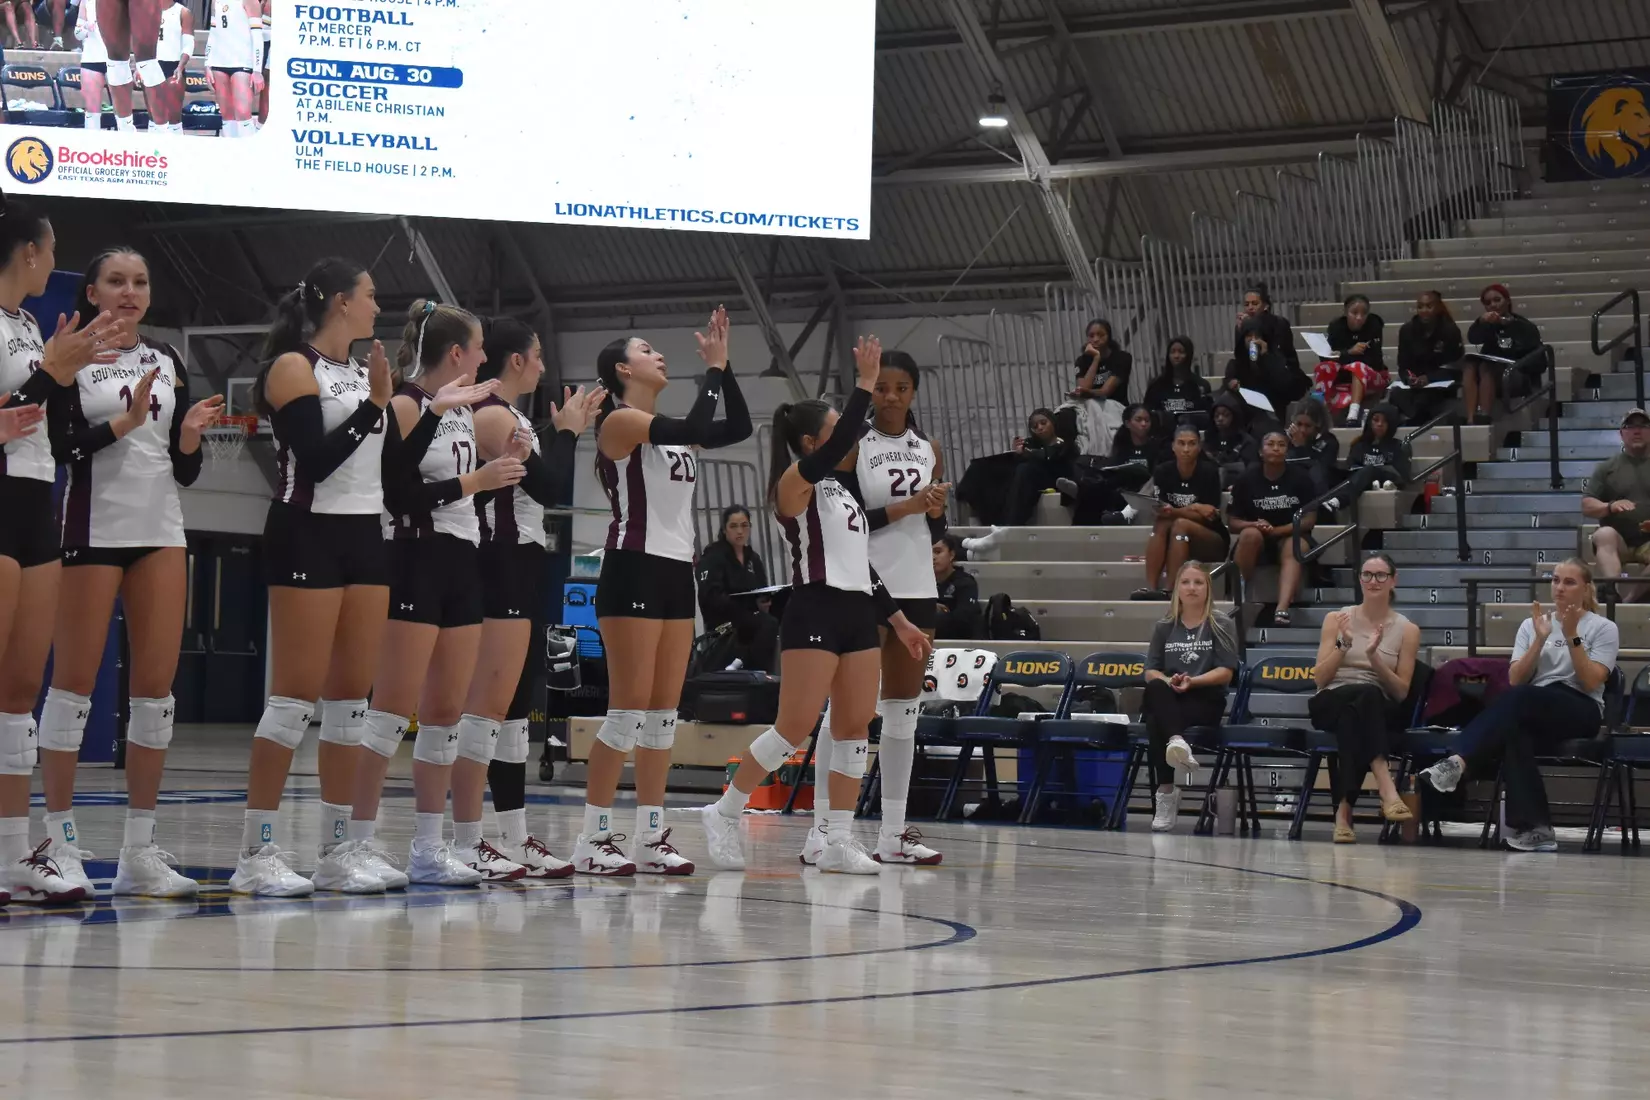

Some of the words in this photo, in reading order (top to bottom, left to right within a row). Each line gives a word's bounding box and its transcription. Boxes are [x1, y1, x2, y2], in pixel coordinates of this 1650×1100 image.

[295, 5, 414, 26] FOOTBALL
[299, 22, 314, 32] AT
[318, 23, 372, 36] MERCER
[299, 35, 305, 45] 7
[310, 35, 335, 47] P.M.
[339, 37, 354, 48] ET
[366, 40, 373, 49] 6
[377, 40, 402, 51] P.M.
[406, 42, 421, 52] CT
[8, 71, 46, 80] LIONS
[290, 61, 342, 77] SUN.
[350, 65, 399, 81] AUG.
[407, 69, 432, 83] 30
[292, 81, 388, 100] SOCCER
[296, 98, 311, 109] AT
[316, 99, 371, 112] ABILENE
[376, 103, 445, 117] CHRISTIAN
[296, 112, 302, 121] 1
[307, 112, 332, 123] P.M.
[291, 129, 437, 151] VOLLEYBALL
[296, 146, 323, 157] ULM
[58, 166, 92, 175] OFFICIAL
[95, 168, 129, 177] GROCERY
[132, 170, 155, 178] STORE
[158, 171, 168, 179] OF
[295, 159, 320, 170] THE
[325, 160, 361, 172] FIELD
[366, 162, 408, 175] HOUSE
[421, 166, 427, 176] 2
[431, 166, 456, 178] P.M.
[554, 202, 859, 231] LIONATHLETICS.COM/TICKETS
[91, 367, 136, 384] SOUTHERN
[452, 441, 472, 475] 17
[666, 450, 696, 483] 20
[888, 468, 922, 497] 22
[843, 502, 866, 535] 21
[1005, 661, 1060, 675] LIONS
[1087, 662, 1144, 676] LIONS
